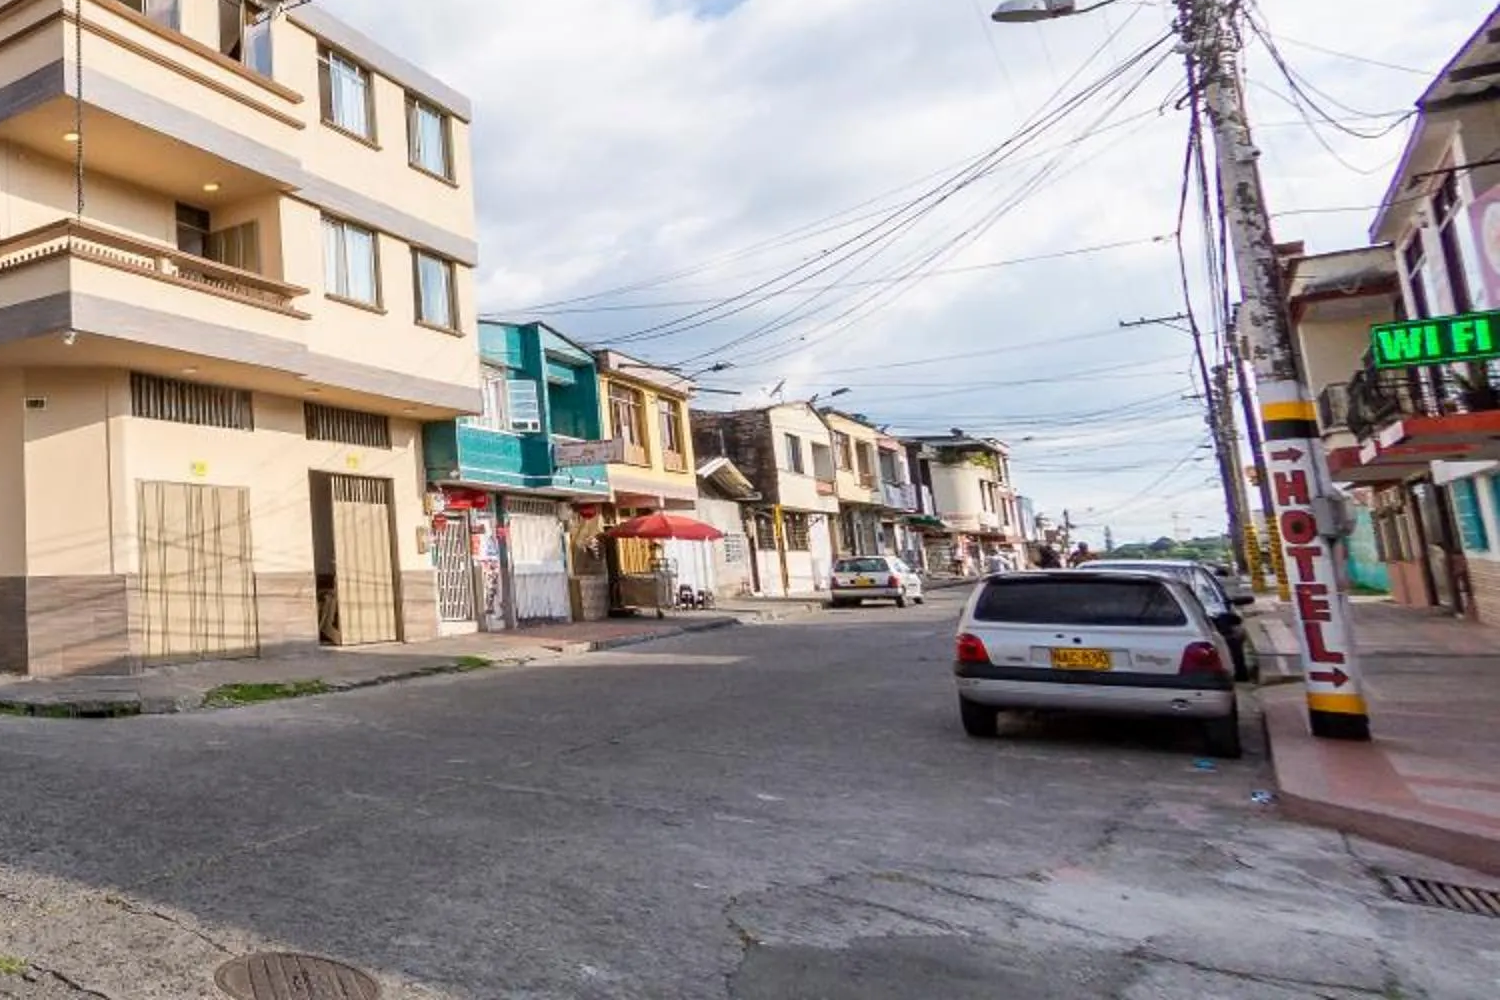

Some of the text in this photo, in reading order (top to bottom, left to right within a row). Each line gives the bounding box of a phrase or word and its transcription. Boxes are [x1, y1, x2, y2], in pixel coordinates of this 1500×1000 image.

[1378, 319, 1492, 361] WI FI
[1273, 469, 1345, 665] HOTEL
